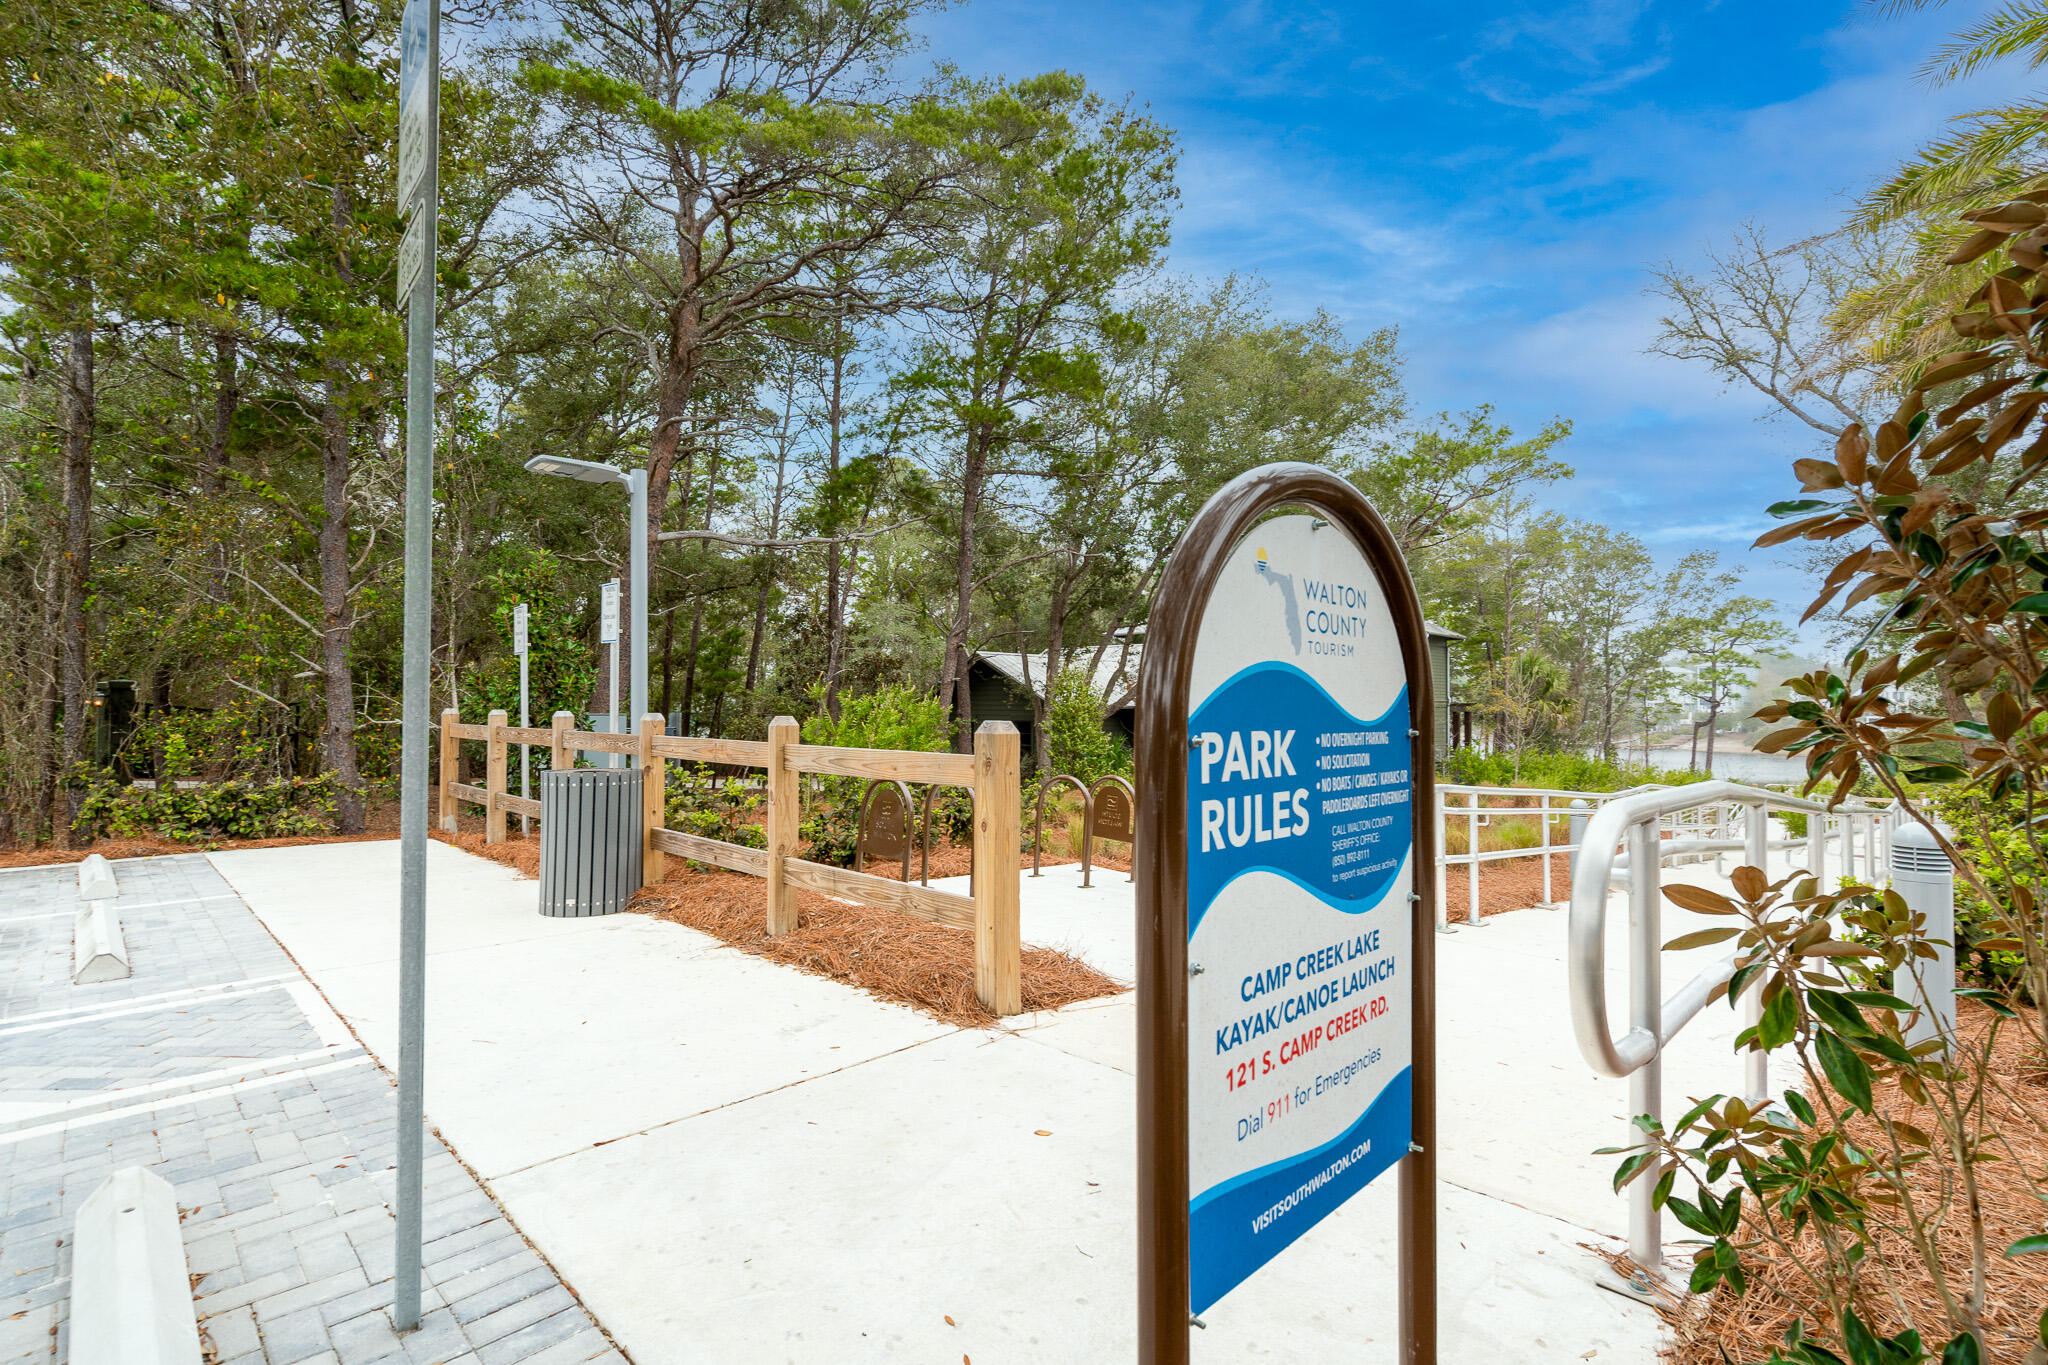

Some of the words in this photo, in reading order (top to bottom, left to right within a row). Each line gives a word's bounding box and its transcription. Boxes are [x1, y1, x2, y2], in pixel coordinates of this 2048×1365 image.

[1303, 578, 1367, 609] WALTON
[1306, 610, 1367, 638] COUNTY
[1308, 641, 1354, 657] TOURISM
[1321, 733, 1331, 748] NO
[1332, 732, 1365, 747] OVERNIGHT
[1366, 731, 1389, 745] PARKING
[1201, 730, 1297, 784] PARK
[1321, 755, 1331, 770] NO
[1332, 753, 1370, 769] SOLICITATION
[1321, 777, 1331, 792] NO
[1332, 775, 1351, 791] BOATS
[1355, 772, 1377, 788] CANOES
[1380, 770, 1400, 785] KAYAKS
[1400, 769, 1408, 783] OR
[1322, 794, 1368, 815] PADDLEBOARDS
[1368, 793, 1380, 808] LEFT
[1381, 789, 1409, 805] OVERNIGHT
[1202, 788, 1310, 852] RULES
[1332, 824, 1346, 836] CALL
[1347, 820, 1371, 833] WALTON
[1371, 815, 1394, 829] COUNTY
[1339, 869, 1356, 882] report
[1356, 862, 1381, 876] suspicious
[1241, 962, 1292, 1002] CAMP
[1296, 942, 1344, 980] CREEK
[1347, 929, 1380, 961] LAKE
[1216, 979, 1338, 1056] KAYAK/CANOE
[1342, 956, 1395, 998] LAUNCH
[1226, 1057, 1256, 1092] 121
[1262, 1050, 1276, 1075] S.
[1279, 1026, 1322, 1064] CAMP
[1326, 1004, 1367, 1041] CREEK
[1370, 996, 1389, 1021] RD.
[1237, 1106, 1263, 1142] Dial
[1267, 1094, 1289, 1123] 911
[1294, 1086, 1311, 1109] for
[1315, 1047, 1381, 1096] Emergencies
[1252, 1139, 1371, 1235] VISITSOUTHWALTON.COM
